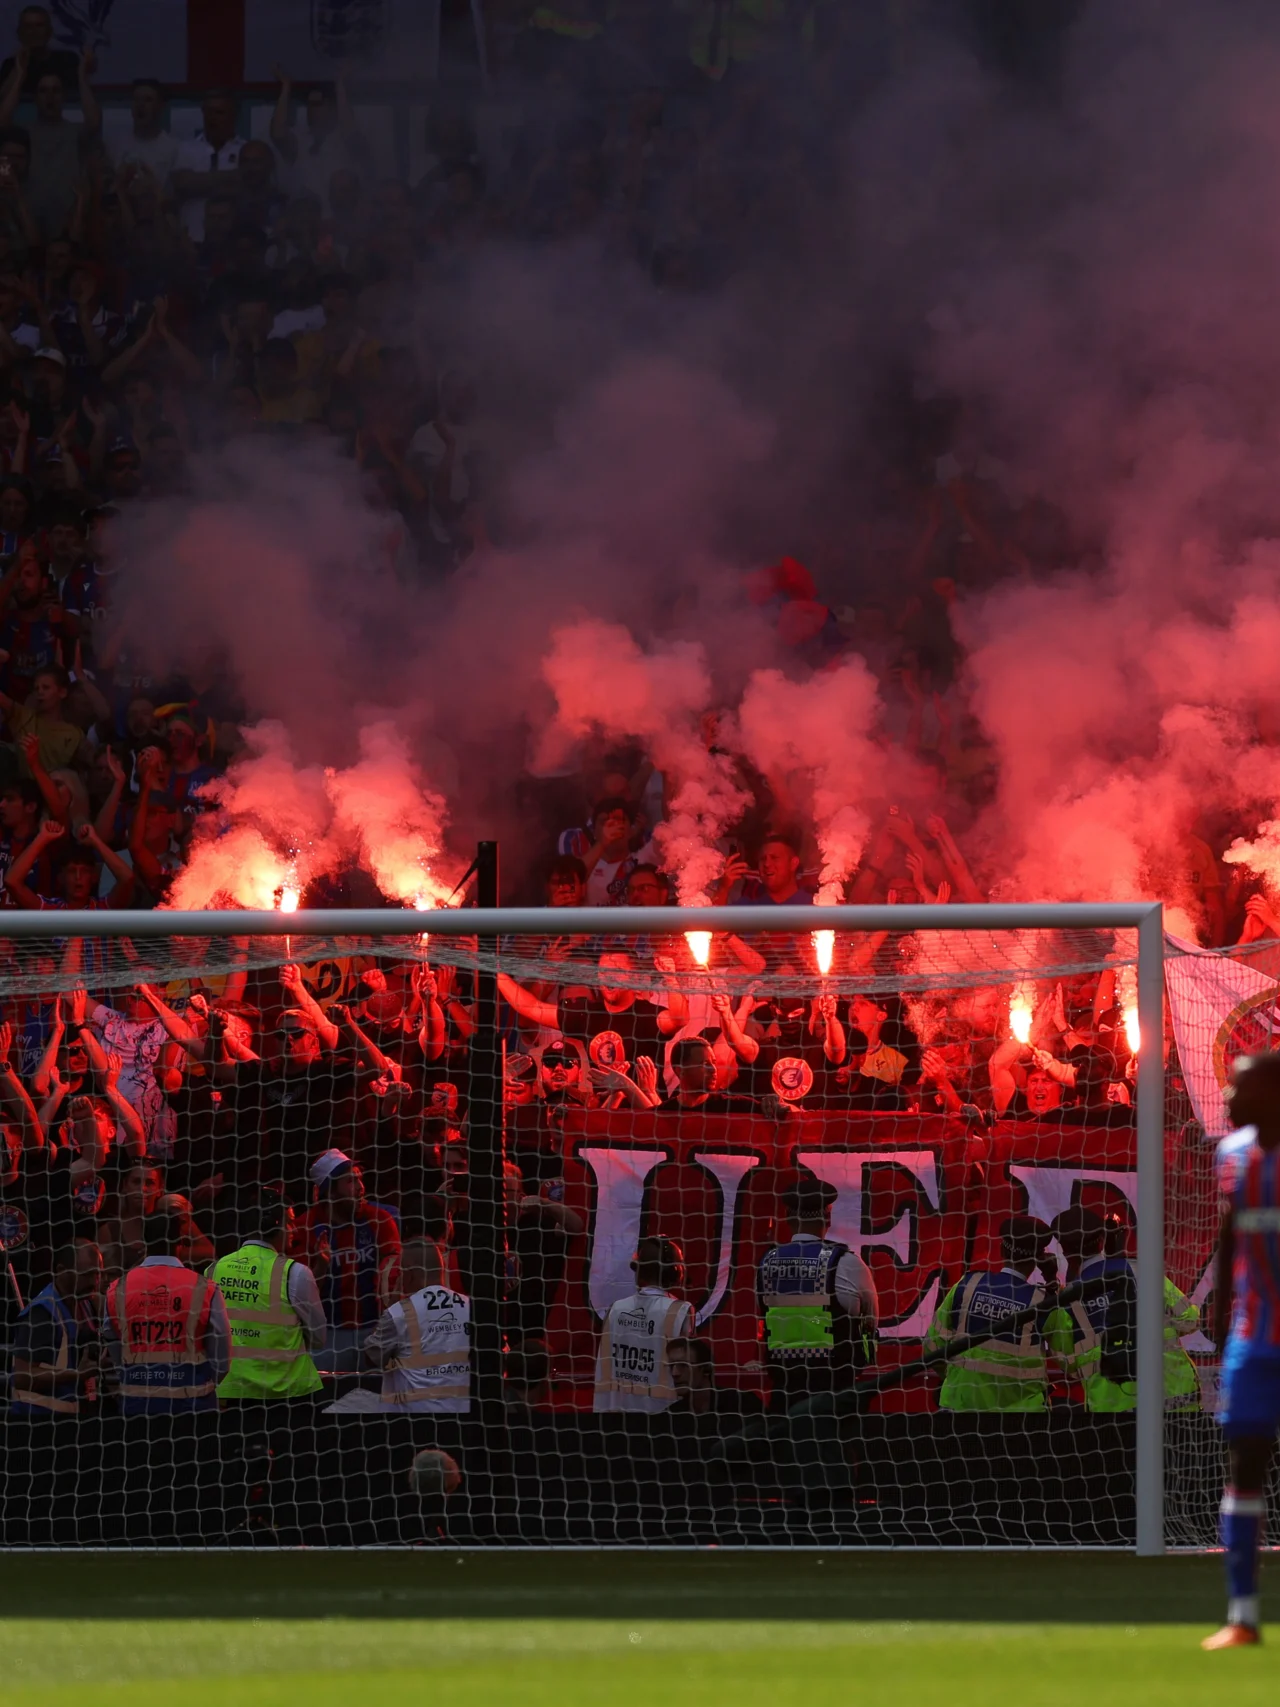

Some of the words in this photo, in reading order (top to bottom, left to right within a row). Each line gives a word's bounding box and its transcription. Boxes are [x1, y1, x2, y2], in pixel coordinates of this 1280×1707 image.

[332, 1247, 376, 1267] TDK
[769, 1265, 817, 1279] POLICE
[220, 1276, 260, 1290] SENIOR
[423, 1289, 466, 1311] 224
[974, 1301, 1014, 1320] POLIC
[427, 1323, 462, 1334] WEMBLEY
[618, 1318, 648, 1328] WEMBLEY
[129, 1370, 153, 1380] HERE
[153, 1370, 166, 1380] TO
[426, 1365, 470, 1377] BROADCA
